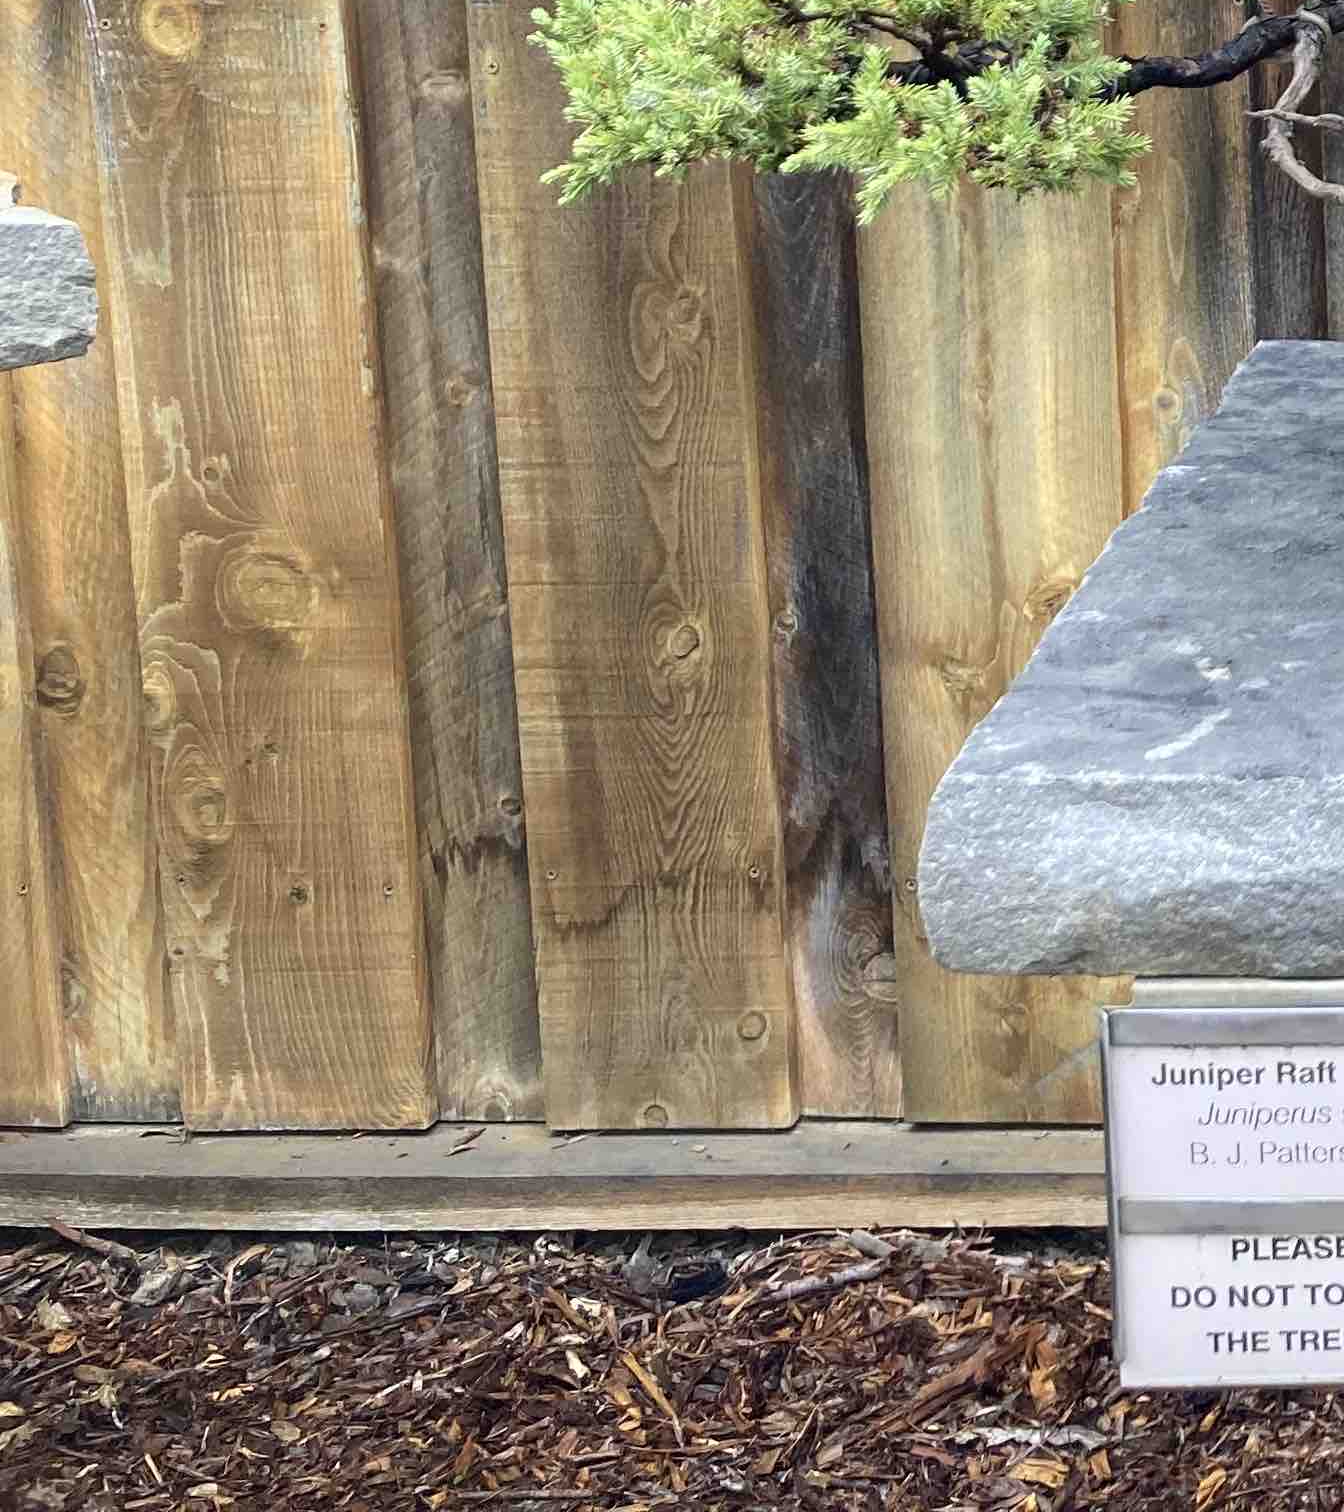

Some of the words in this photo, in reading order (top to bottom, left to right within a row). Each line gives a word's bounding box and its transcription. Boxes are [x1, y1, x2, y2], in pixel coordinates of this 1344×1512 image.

[1151, 1061, 1265, 1090] Juniper
[1276, 1061, 1336, 1085] Raft
[1197, 1102, 1332, 1128] Juniperus
[1190, 1143, 1216, 1165] B.
[1227, 1143, 1248, 1165] J.
[1171, 1286, 1216, 1309] DO
[1228, 1285, 1294, 1307] NOT
[1206, 1331, 1270, 1353] THE
